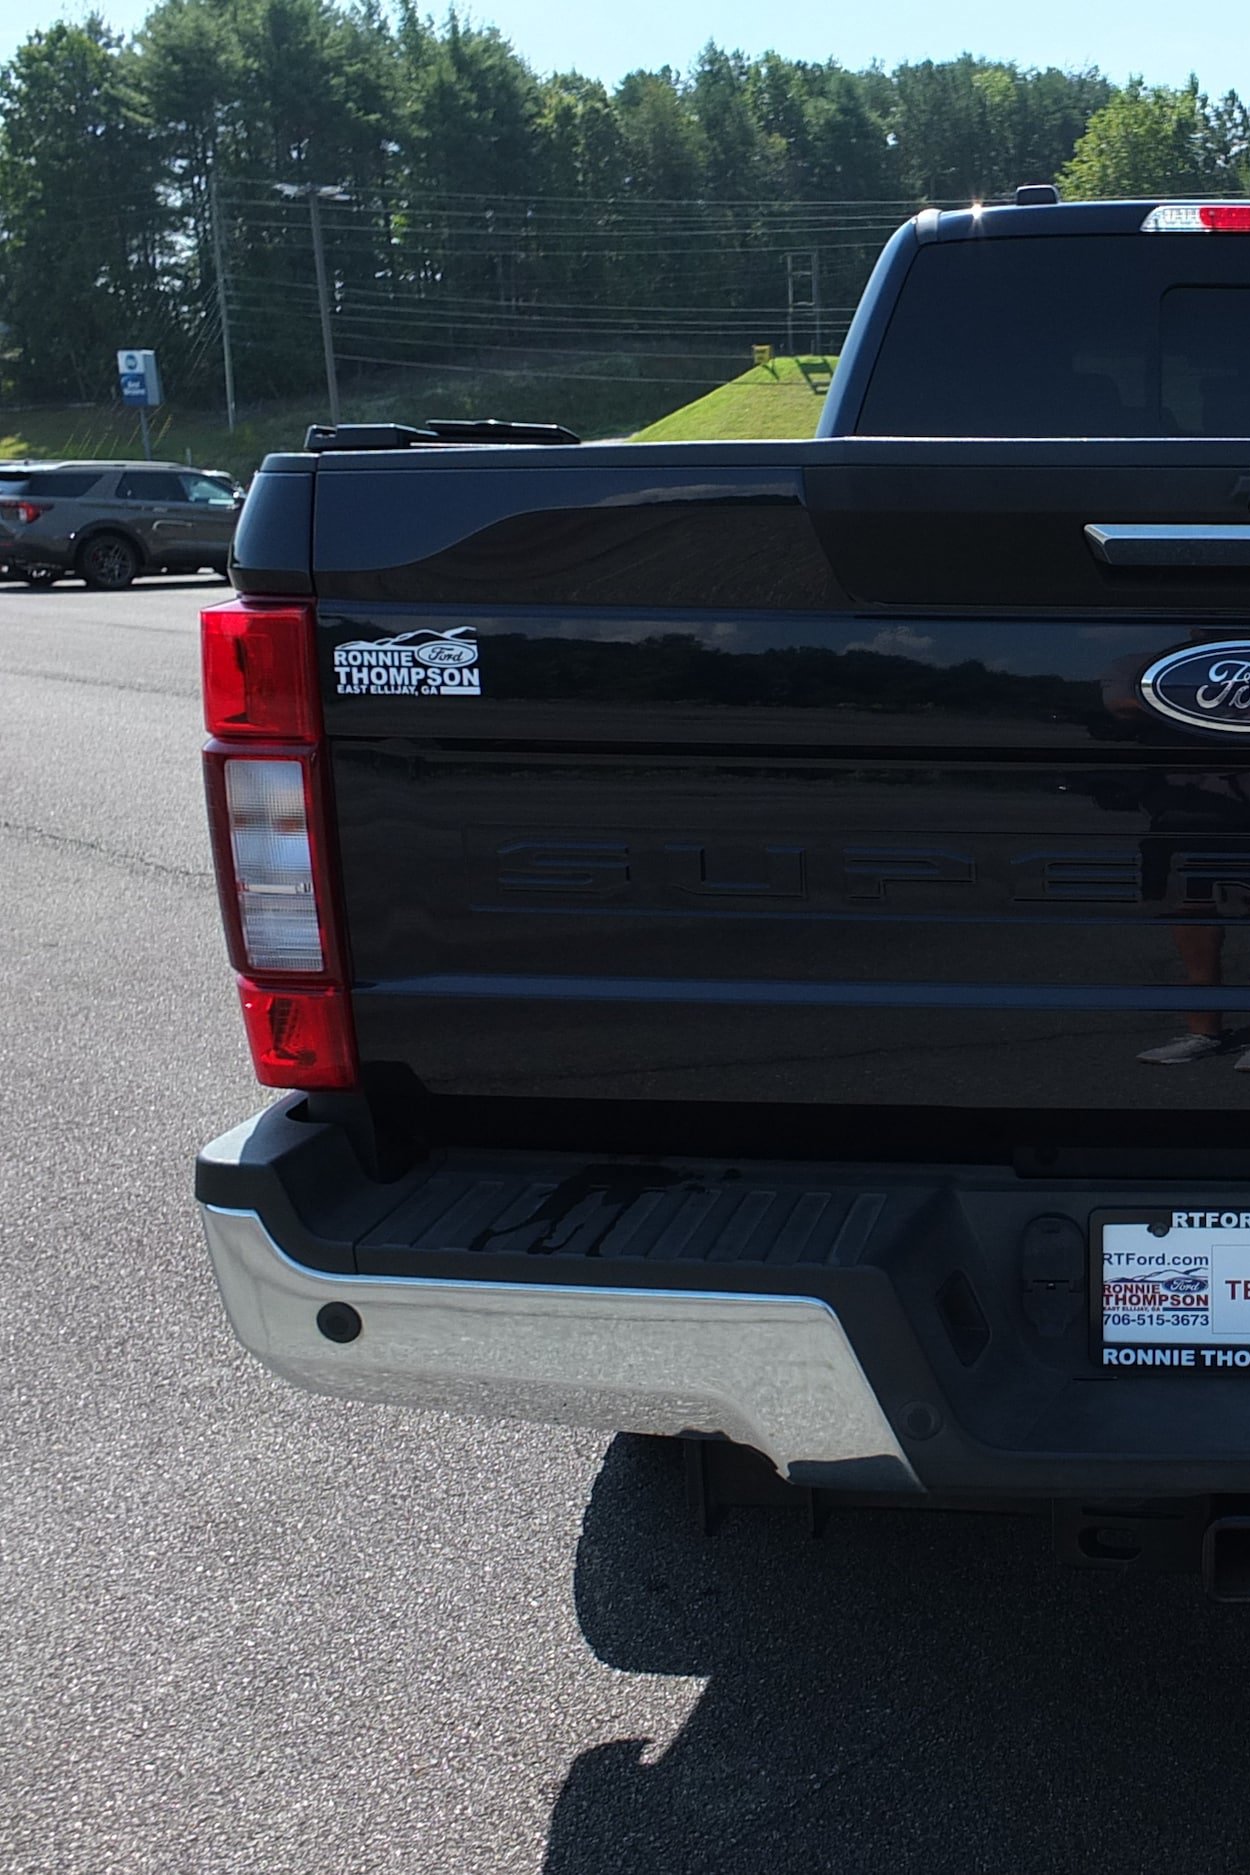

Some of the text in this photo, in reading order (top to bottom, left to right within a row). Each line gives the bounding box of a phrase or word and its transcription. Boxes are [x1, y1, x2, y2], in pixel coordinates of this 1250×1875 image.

[334, 651, 413, 666] RONNIE
[428, 647, 464, 662] Ford
[334, 667, 480, 686] THOMPSON
[337, 685, 438, 696] EAST ELLIJAY, GA
[1103, 1253, 1209, 1266] RTFord.com
[1103, 1284, 1160, 1294] RONNIE
[1103, 1294, 1209, 1307] THOMPSON
[1103, 1314, 1209, 1326] 706-515-3673
[1103, 1349, 1195, 1366] RONNIE
